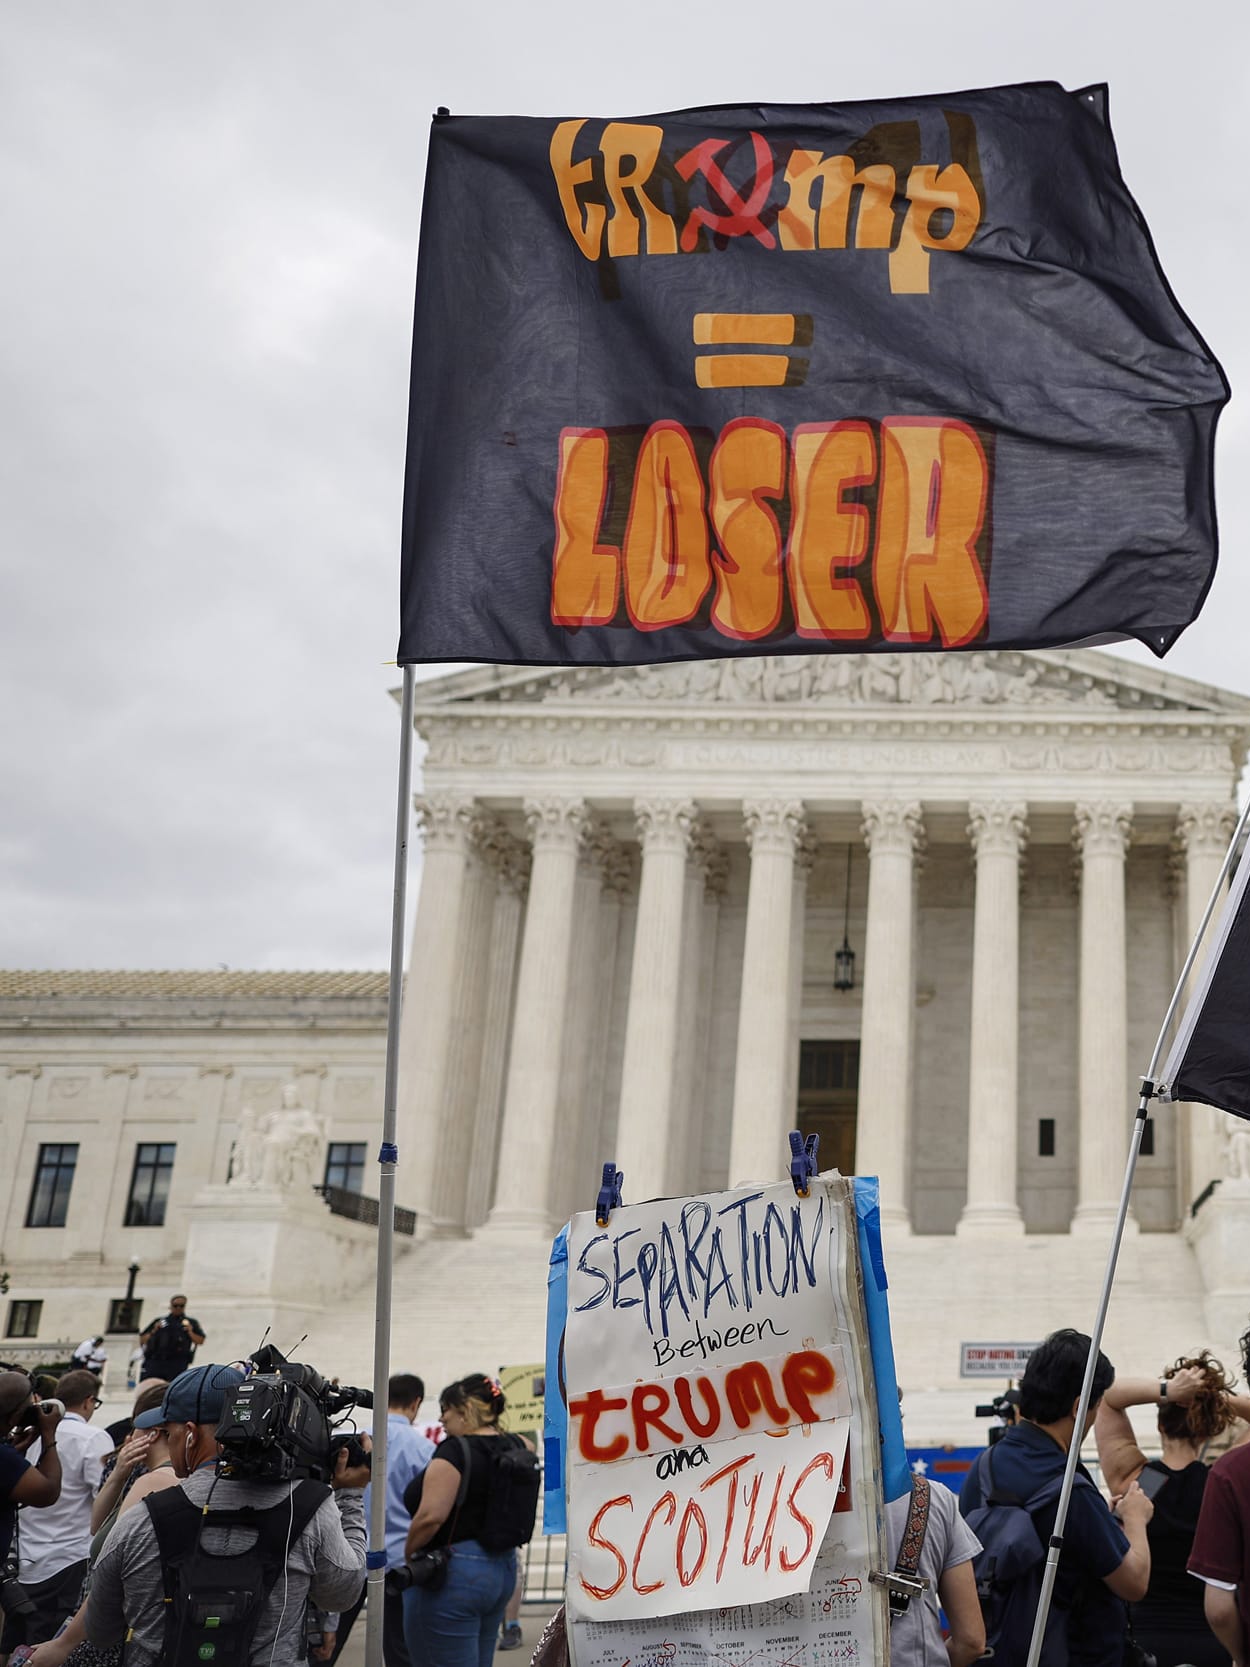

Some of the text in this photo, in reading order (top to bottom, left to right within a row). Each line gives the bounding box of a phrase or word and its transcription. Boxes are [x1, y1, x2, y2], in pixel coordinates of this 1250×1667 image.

[552, 416, 990, 646] LOSER
[575, 1192, 823, 1336] SEPARATION
[652, 1318, 790, 1367] Between
[655, 1444, 710, 1480] and
[579, 1452, 834, 1600] SCOTUS
[716, 1641, 745, 1649] OCTOBER
[765, 1636, 800, 1645] NOVEMBER
[818, 1631, 852, 1639] DECEMBER
